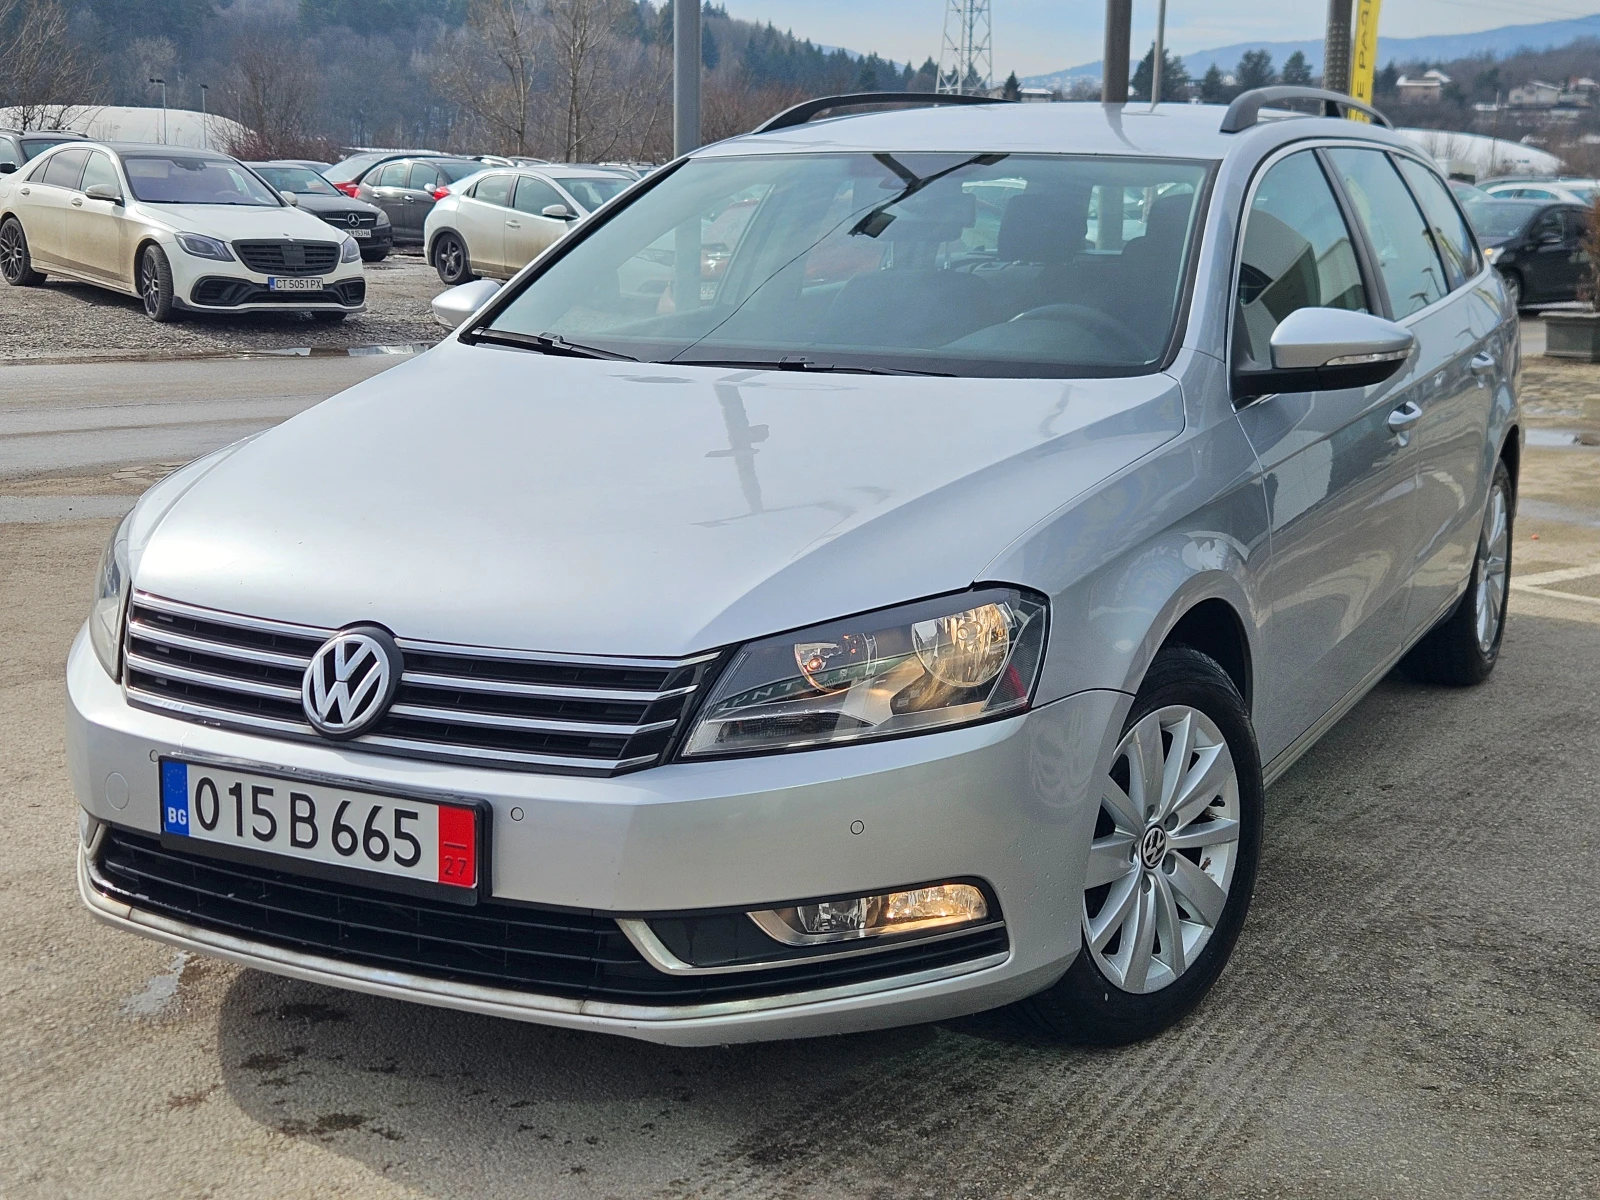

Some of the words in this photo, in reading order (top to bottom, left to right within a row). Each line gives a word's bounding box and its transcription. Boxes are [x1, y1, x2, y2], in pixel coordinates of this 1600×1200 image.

[276, 279, 287, 289] CT
[289, 279, 309, 289] 5051
[167, 806, 187, 825] BG
[195, 776, 277, 842] 015
[331, 800, 421, 868] 665
[444, 855, 467, 877] 27
